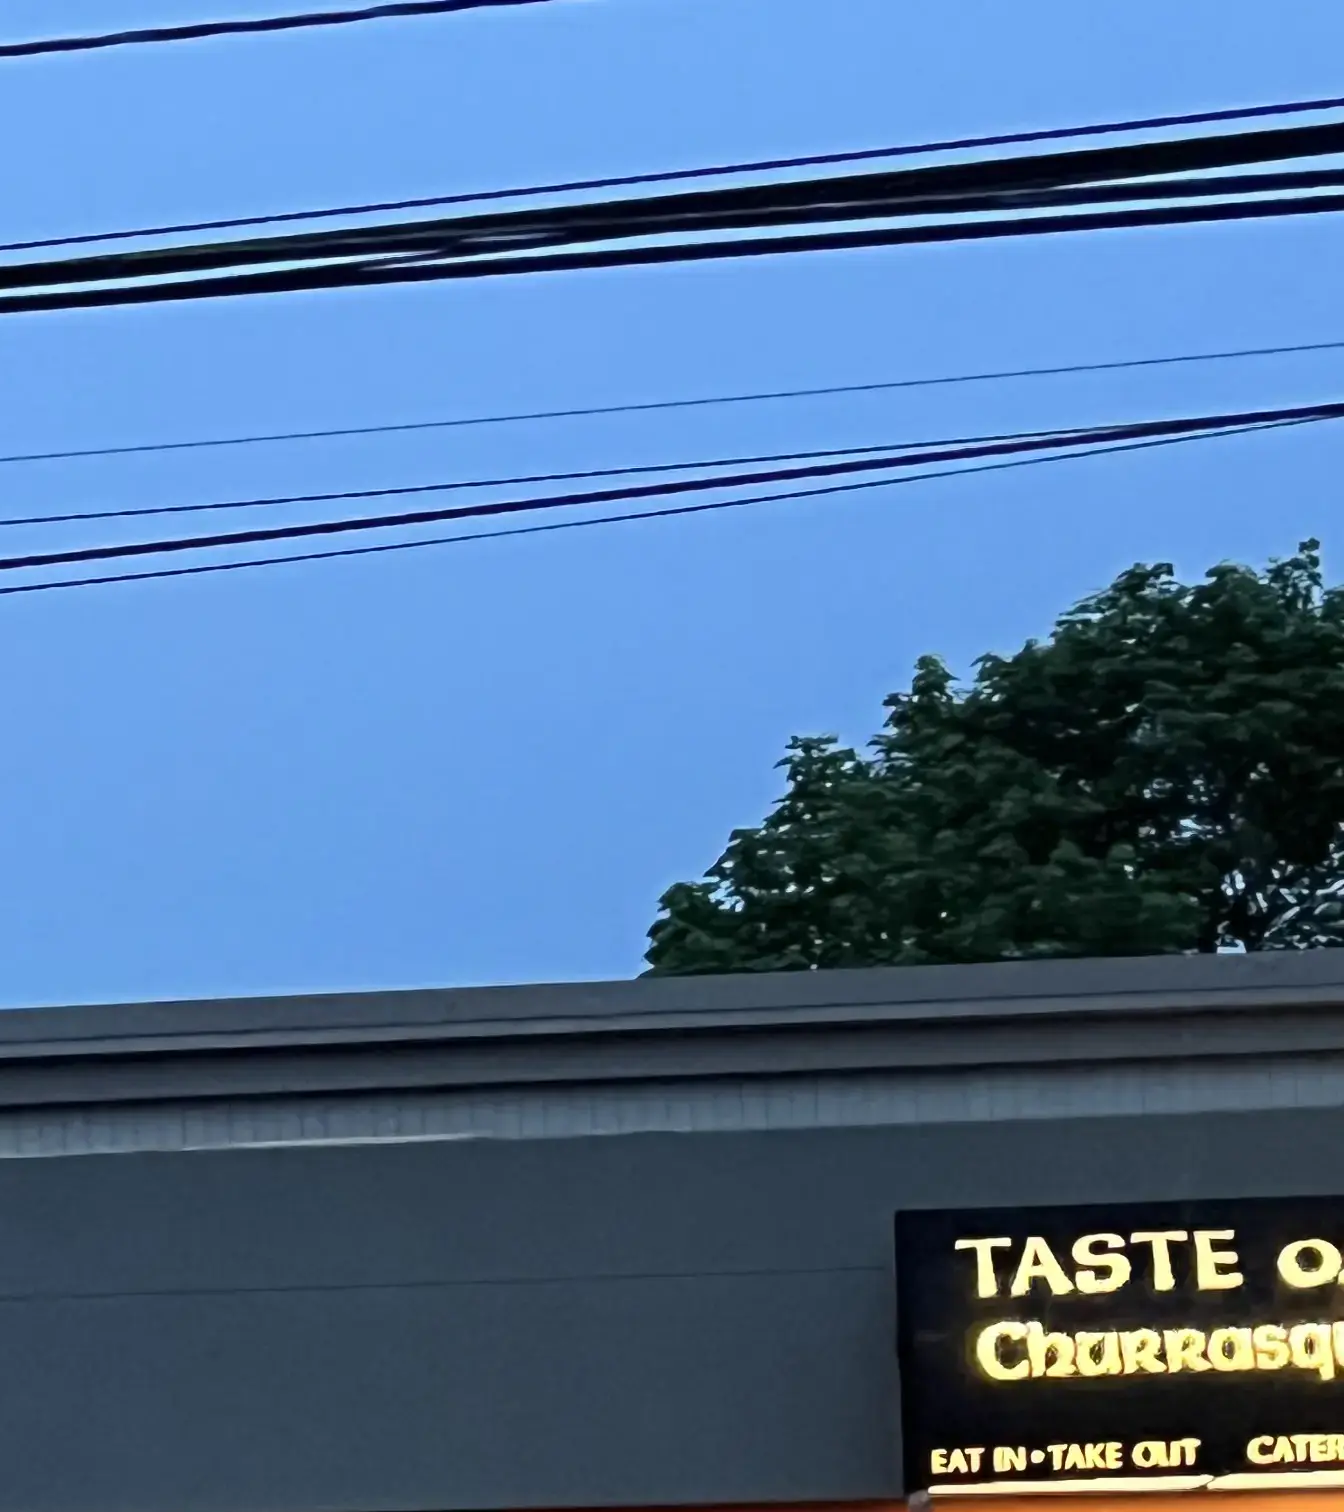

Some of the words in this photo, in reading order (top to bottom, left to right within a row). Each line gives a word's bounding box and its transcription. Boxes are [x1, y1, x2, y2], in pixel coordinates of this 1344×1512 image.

[955, 1229, 1245, 1298] TASTE
[1277, 1238, 1344, 1289] O
[931, 1446, 985, 1474] EAT
[1132, 1437, 1201, 1468] OUT
